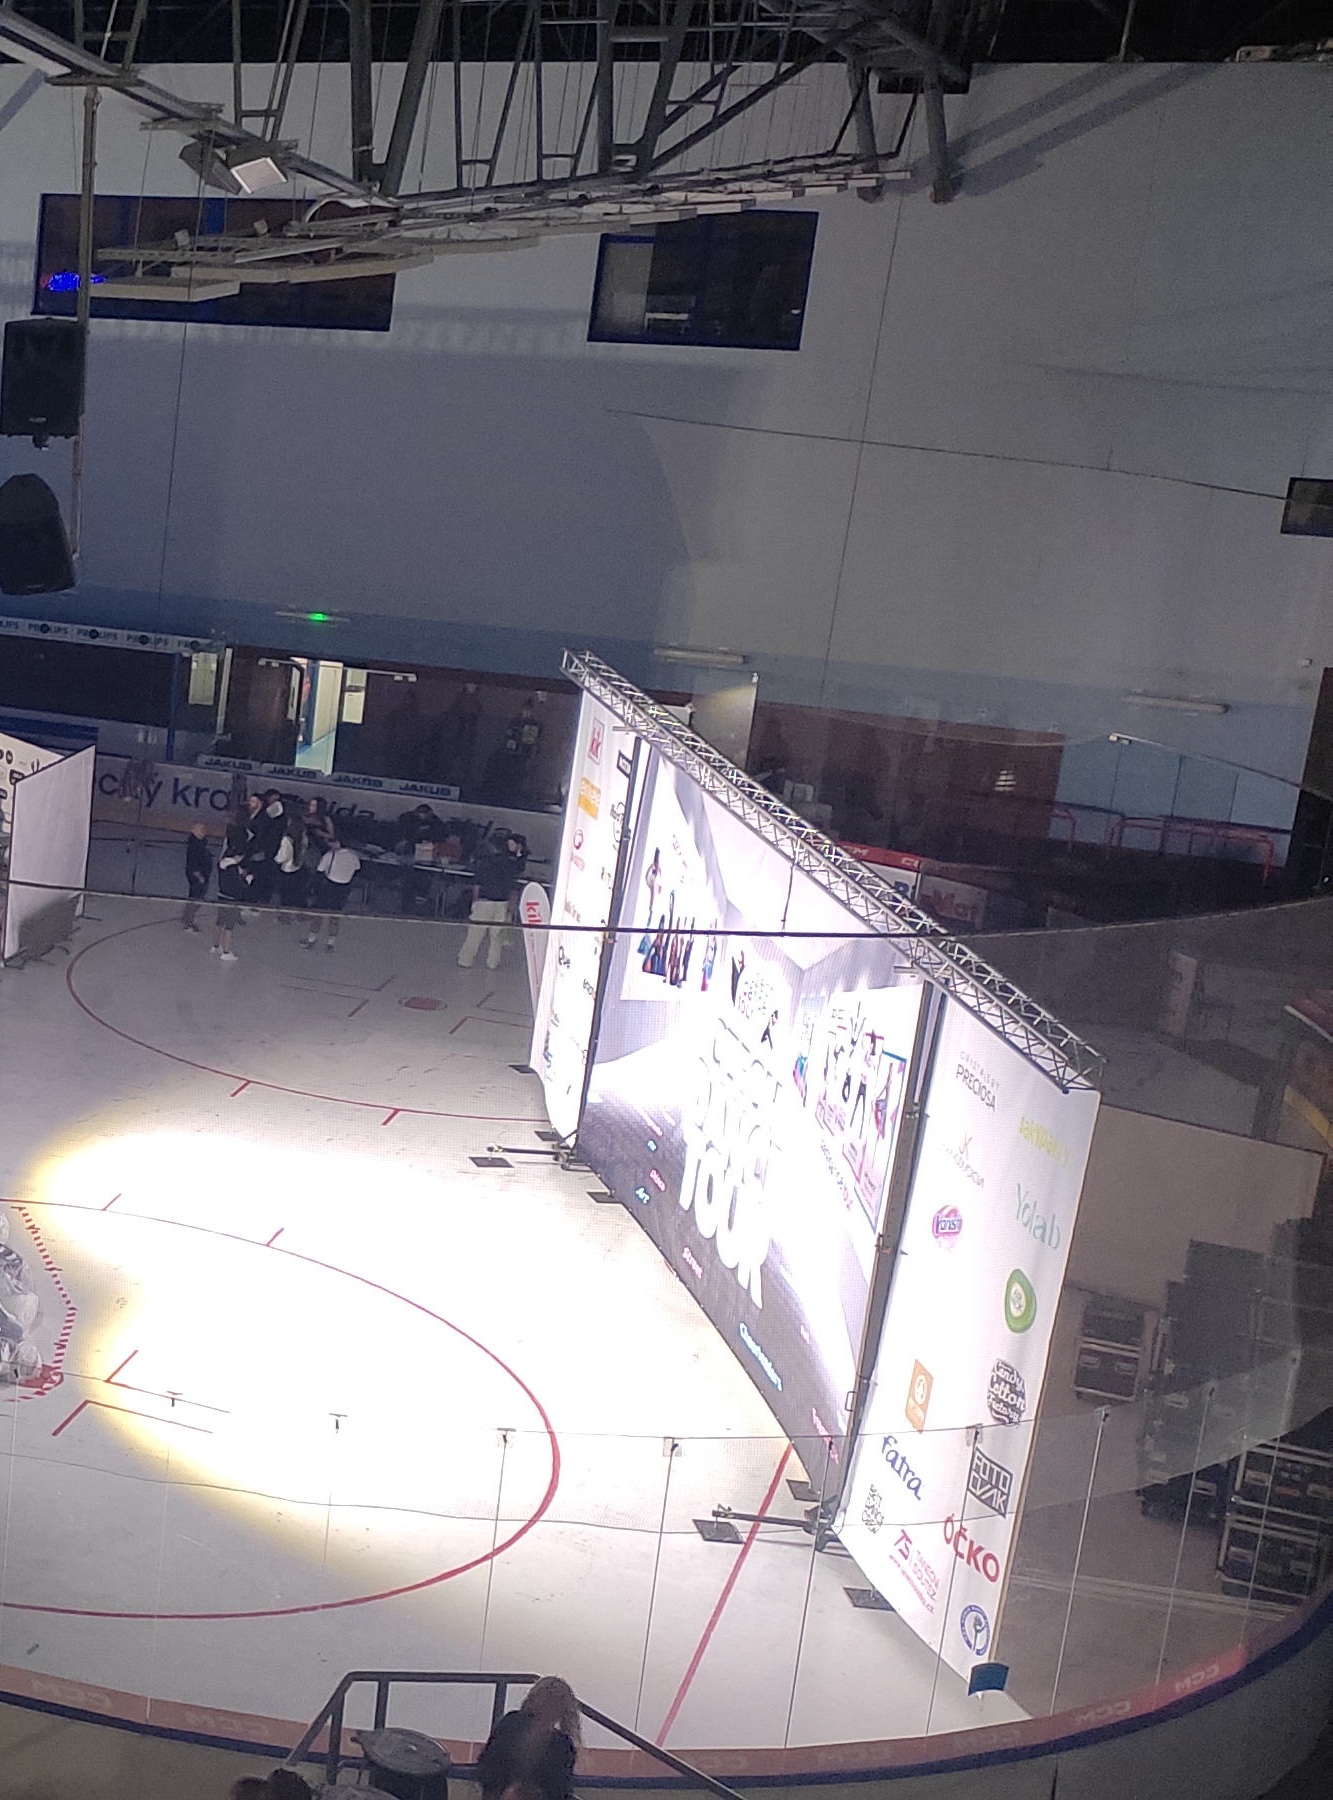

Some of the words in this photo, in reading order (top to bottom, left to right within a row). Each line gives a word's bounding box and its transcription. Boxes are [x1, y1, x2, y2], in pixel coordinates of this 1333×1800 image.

[204, 757, 253, 772] JAKUB
[268, 766, 317, 780] JAKUB
[171, 781, 233, 813] kra
[399, 782, 451, 797] JAKUB
[956, 1064, 996, 1112] PRECIOSA
[1016, 1183, 1062, 1250] Yolab
[882, 1434, 923, 1501] fatra
[973, 1452, 1012, 1495] FOTO
[943, 1513, 1000, 1583] ÓČKO
